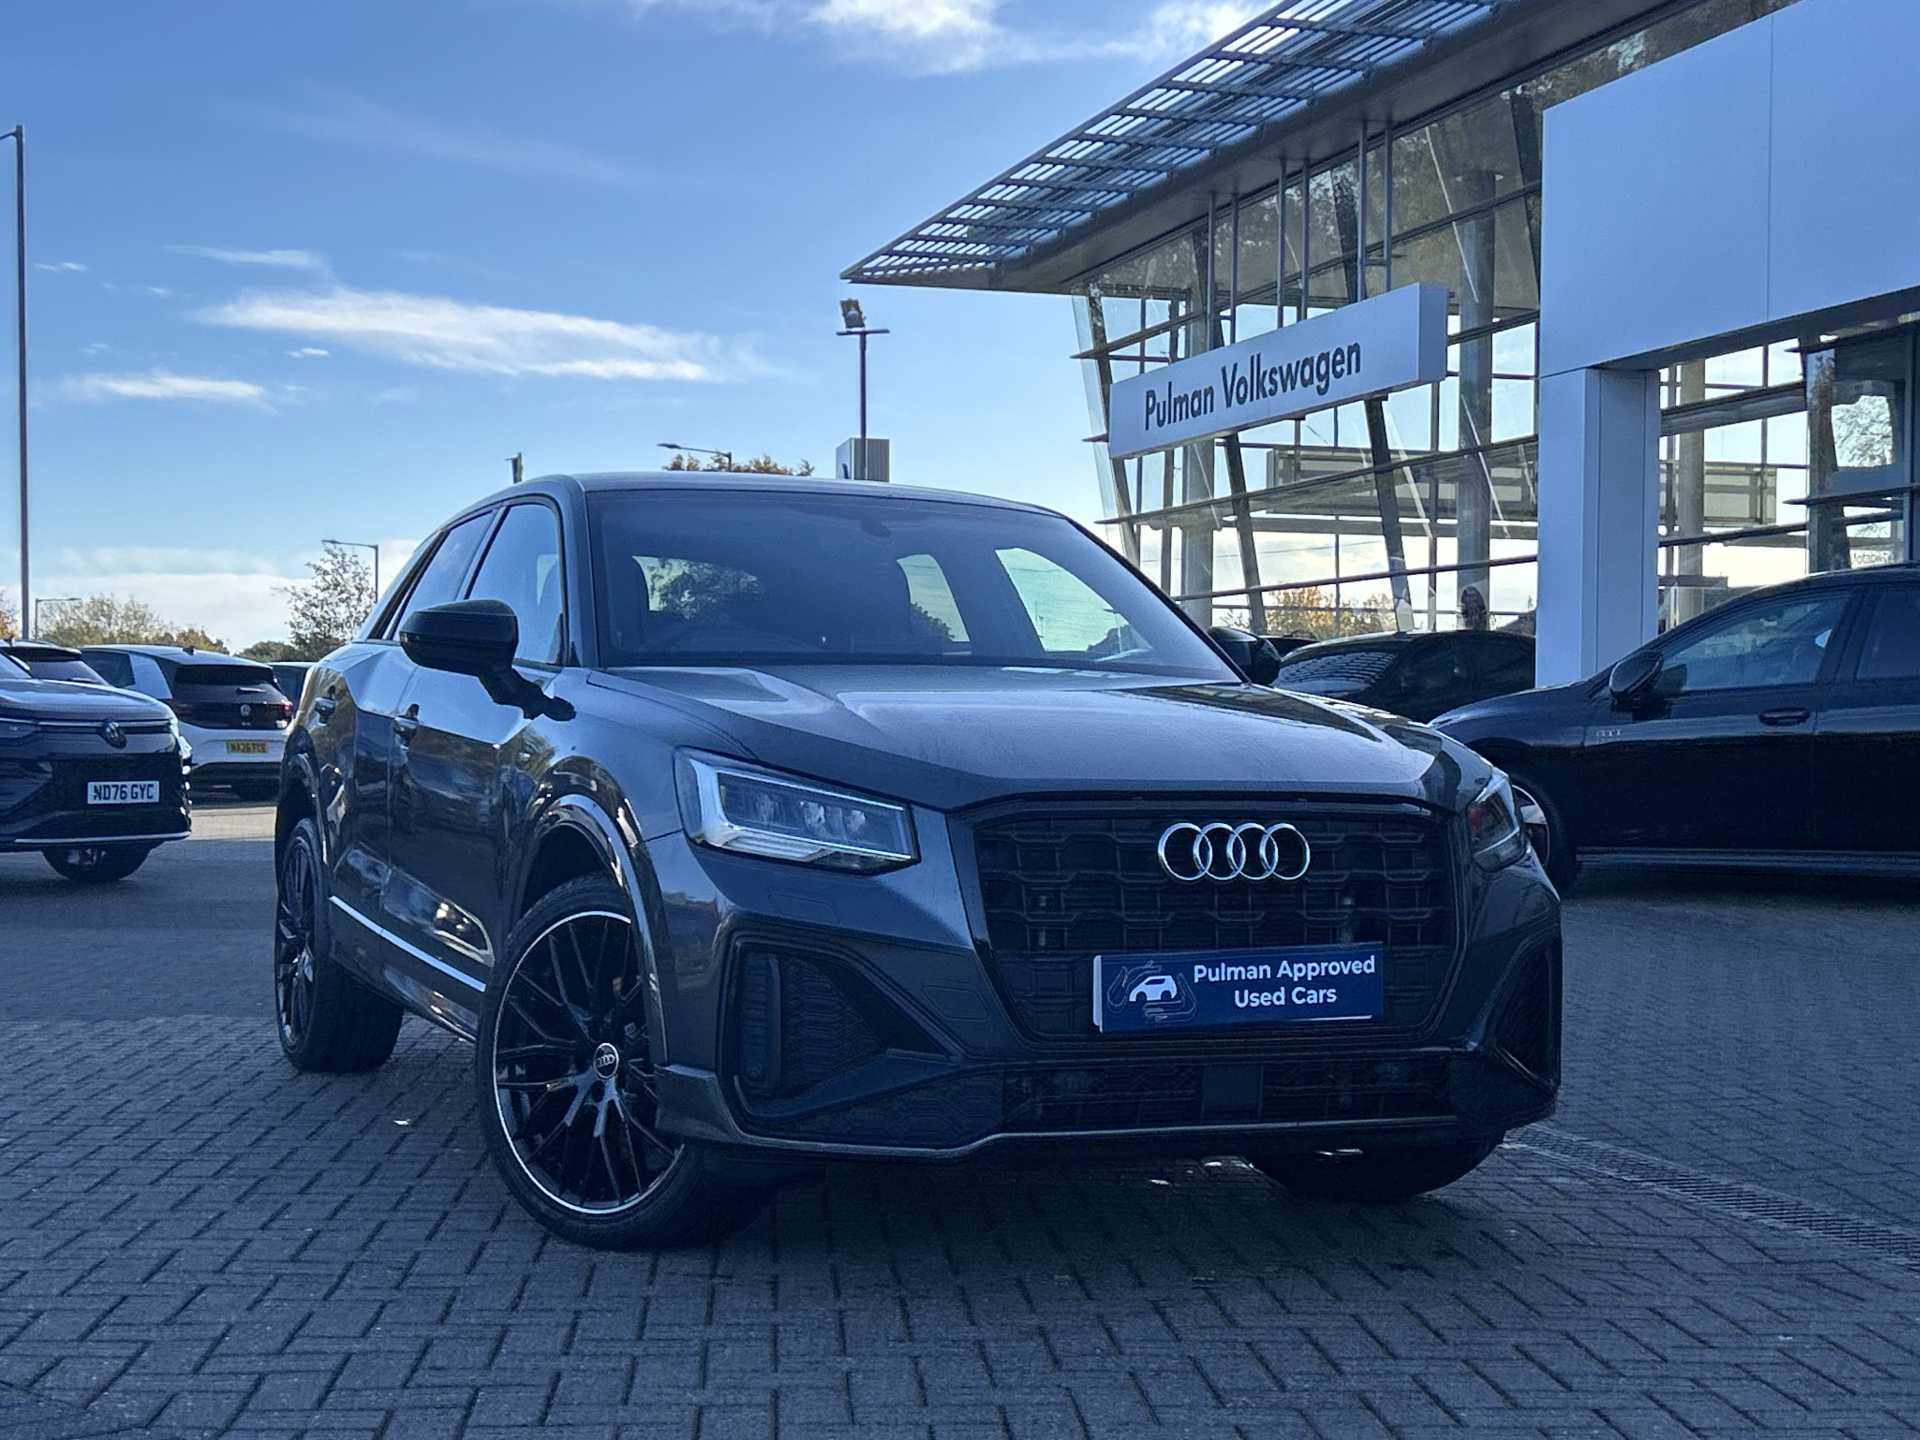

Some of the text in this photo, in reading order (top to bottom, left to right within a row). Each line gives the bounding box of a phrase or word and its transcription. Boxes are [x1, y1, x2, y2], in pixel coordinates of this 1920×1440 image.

[1144, 341, 1361, 431] Pulman Volkswagen
[94, 783, 154, 801] ND76 GYC
[1193, 955, 1375, 983] Pulman Approved
[1234, 984, 1337, 1008] Used Cars
